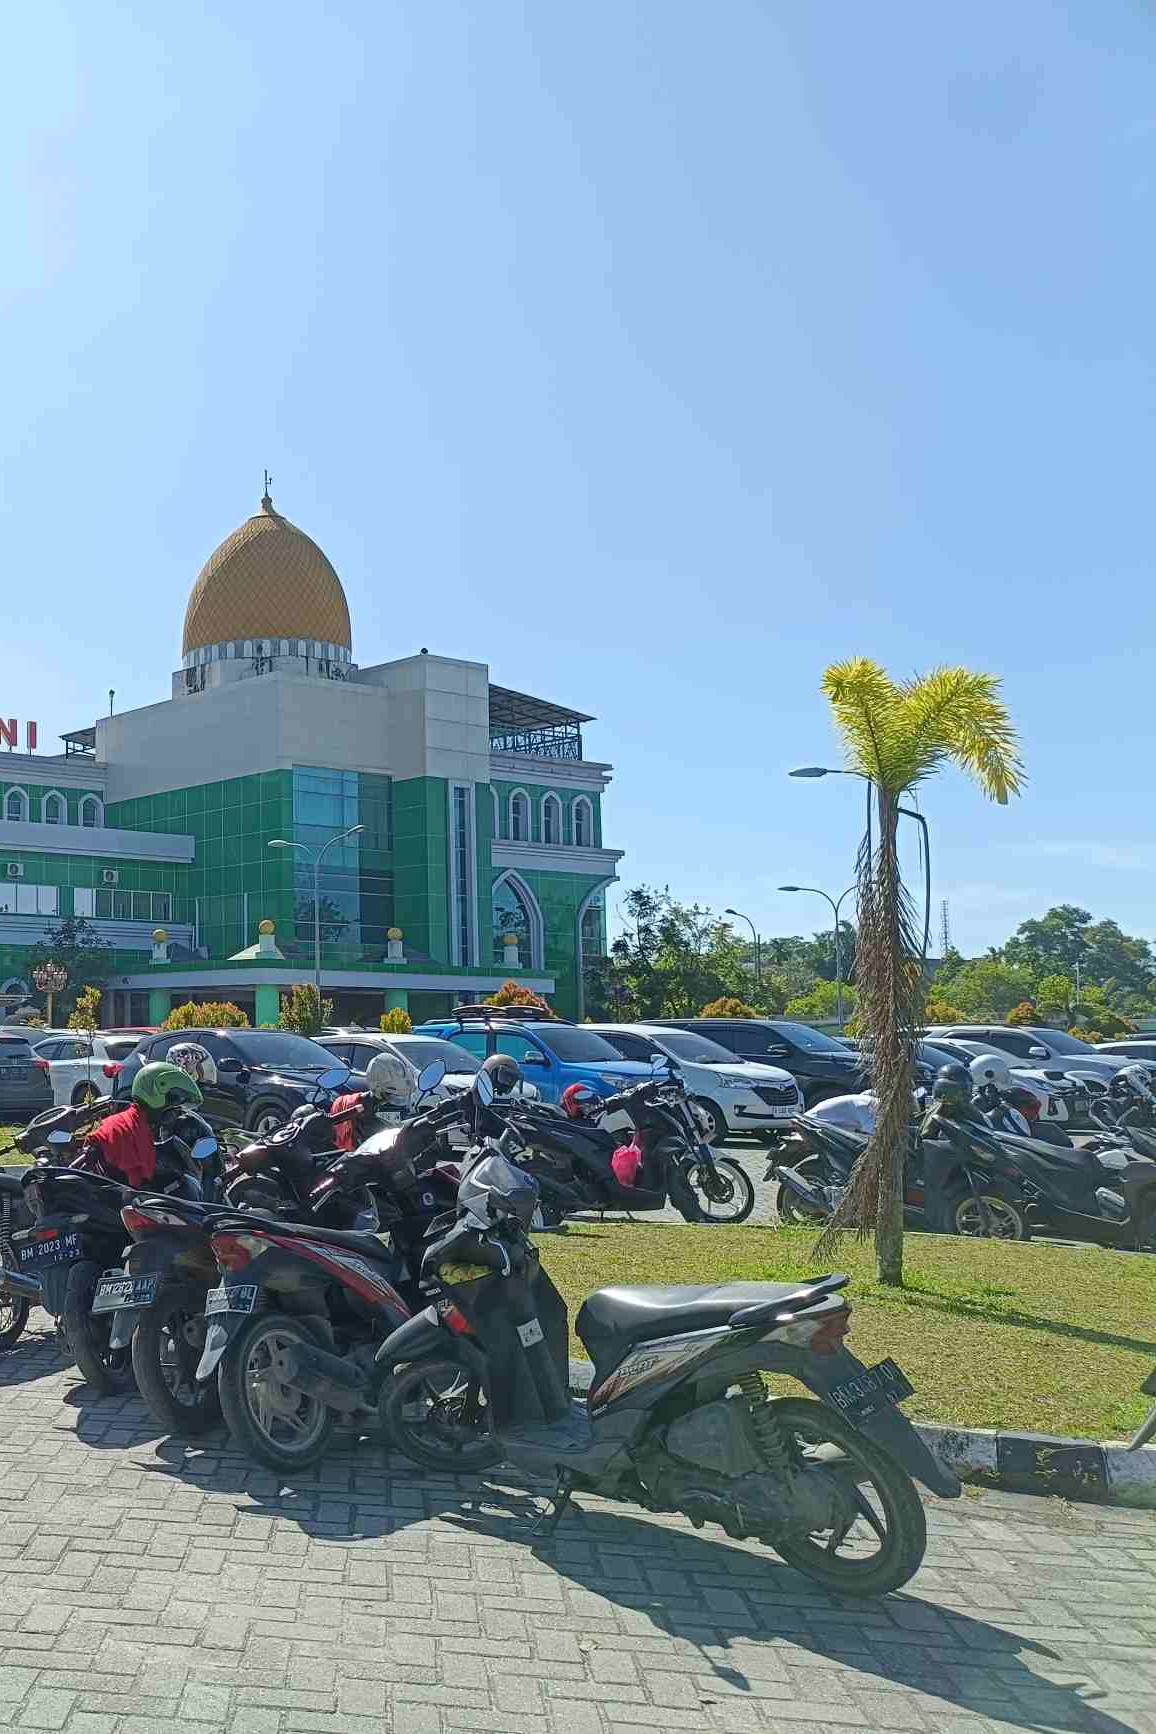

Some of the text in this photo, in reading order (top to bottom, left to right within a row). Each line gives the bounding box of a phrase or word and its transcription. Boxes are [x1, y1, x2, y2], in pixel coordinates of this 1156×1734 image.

[20, 1233, 77, 1261] BM 2023 MF
